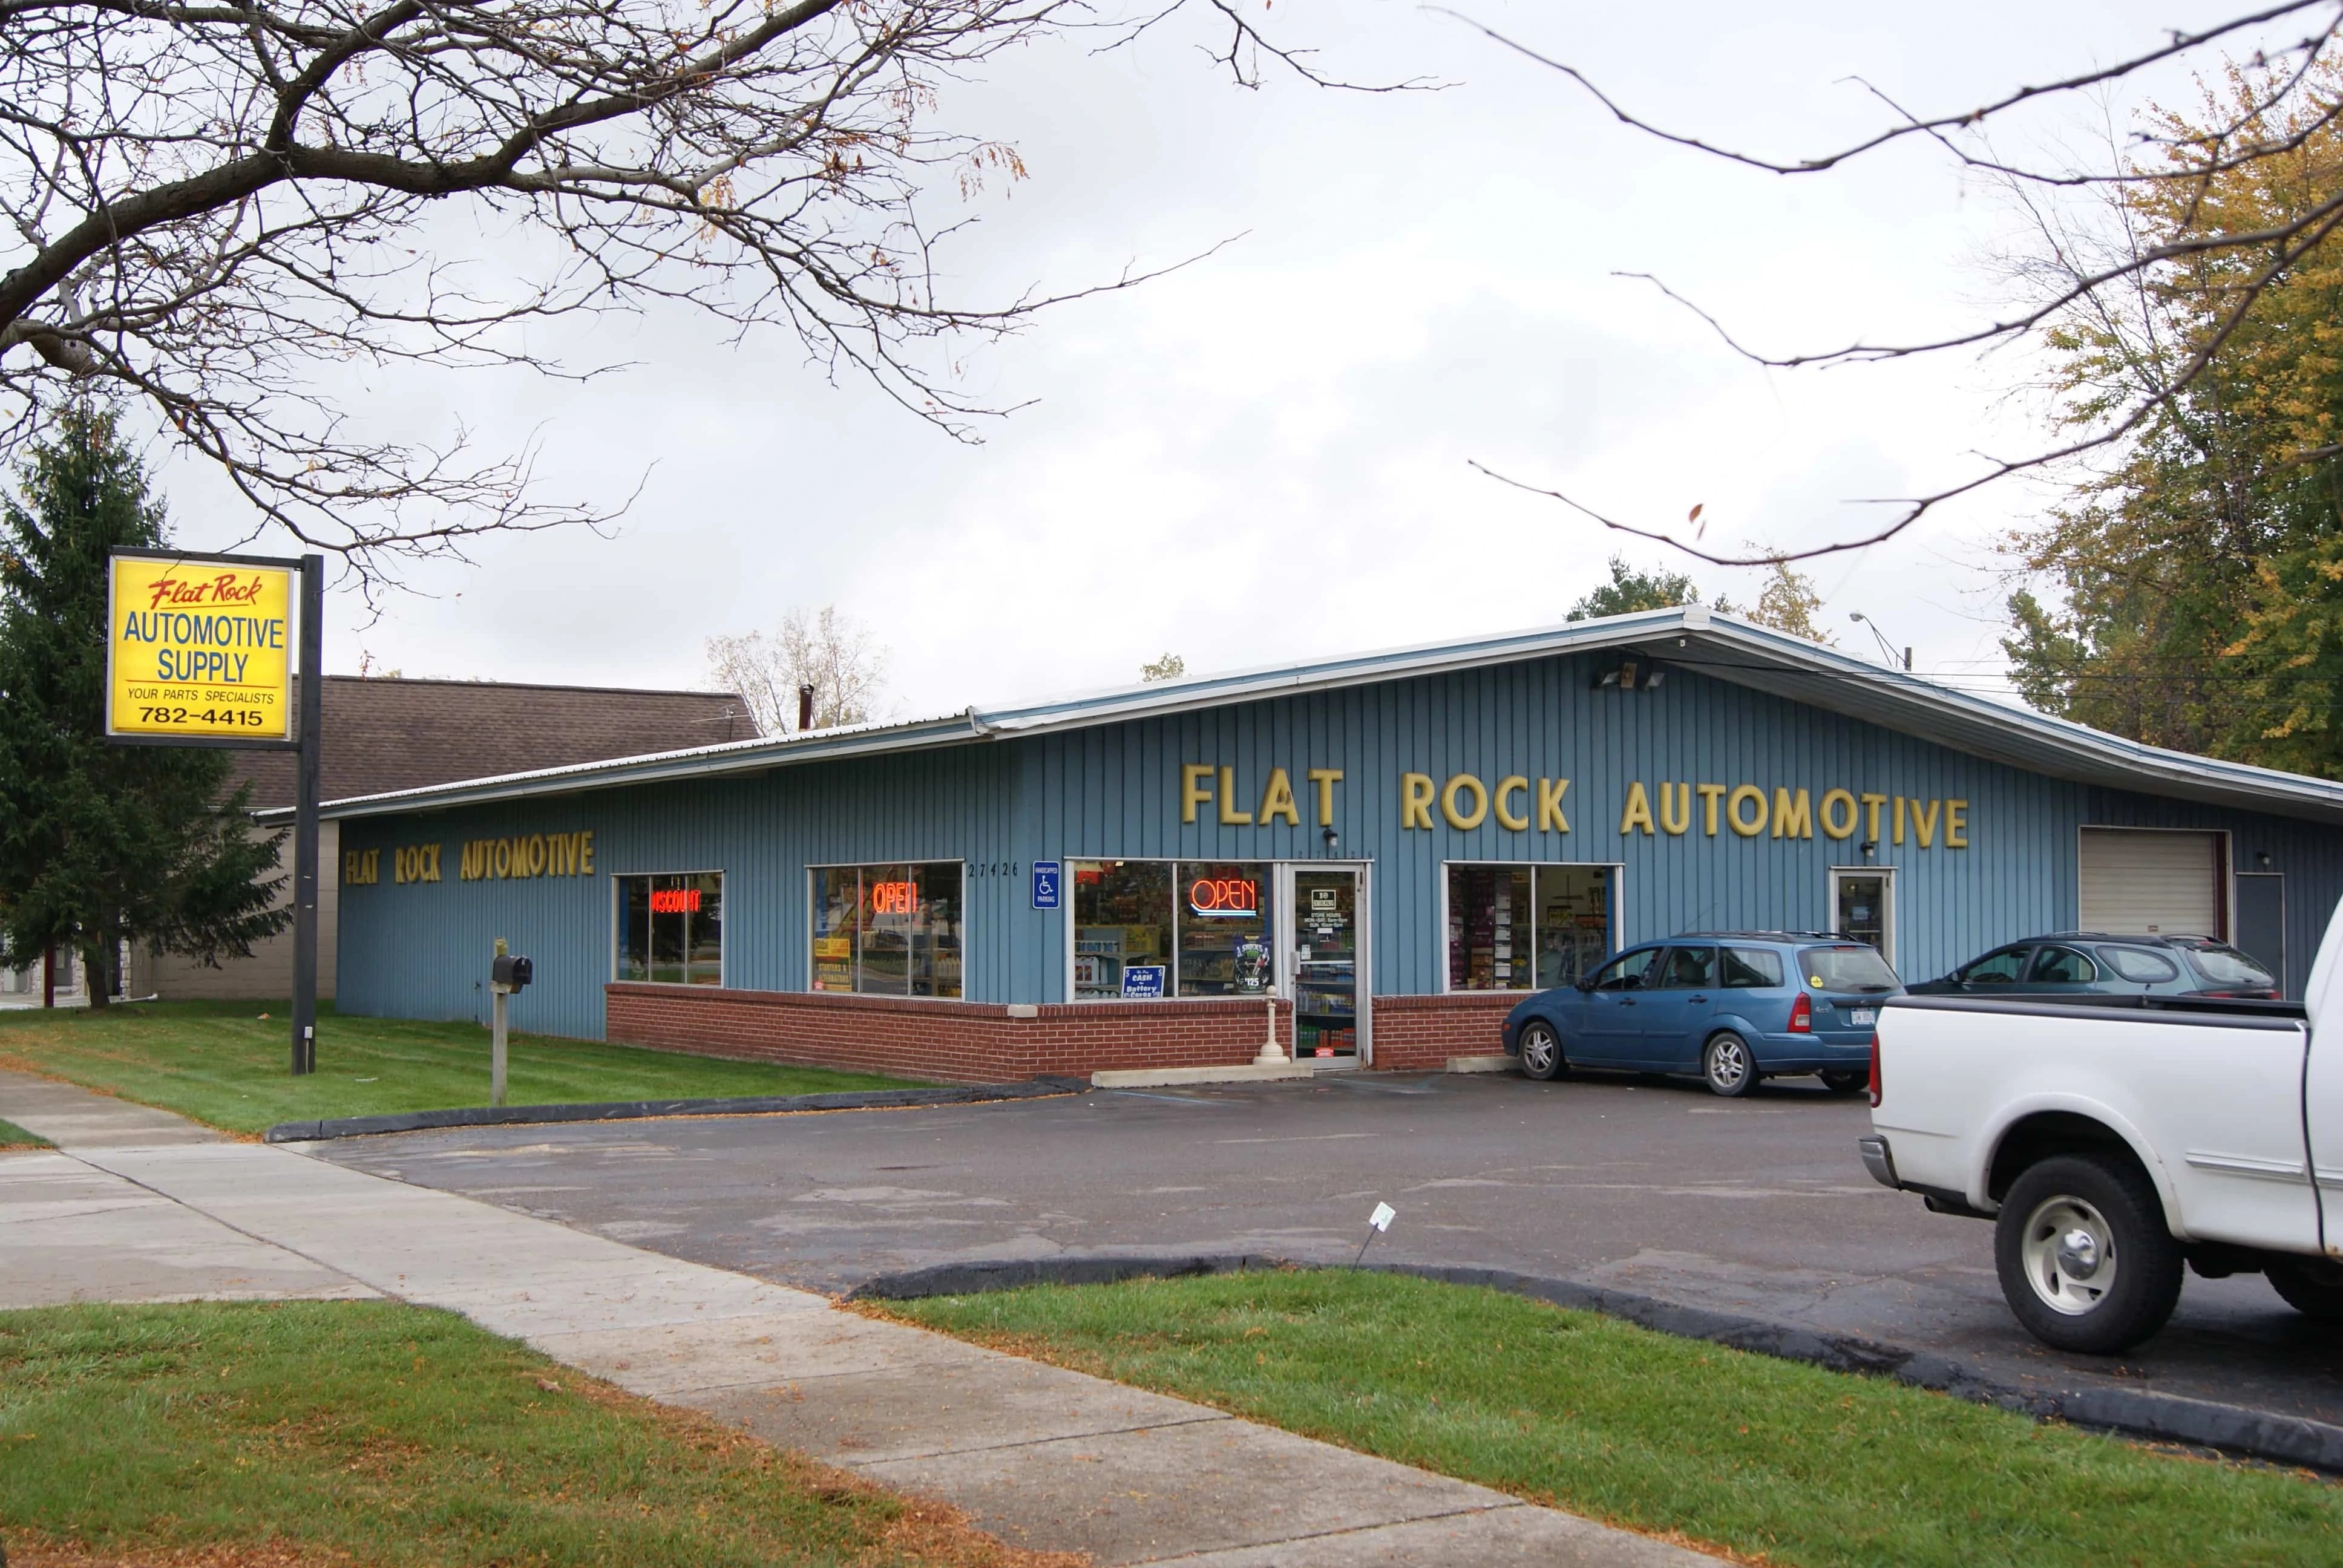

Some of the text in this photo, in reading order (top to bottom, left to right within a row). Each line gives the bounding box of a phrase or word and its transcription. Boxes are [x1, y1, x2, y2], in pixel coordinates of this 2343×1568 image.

[148, 574, 263, 610] Flat Rock
[123, 611, 284, 648] AUTOMOTIVE
[157, 648, 249, 682] SUPPLY
[128, 688, 274, 705] YOUR PARTS SPECIALISTS
[139, 707, 263, 727] 782-4415
[1182, 763, 1969, 849] FLAT ROCK AUTOMOTIVE
[345, 830, 595, 885] FLAT ROCK AUTOMOTIVE
[969, 862, 1017, 877] 27426
[873, 882, 917, 914] OPEN
[1191, 880, 1255, 910] OPEN
[1242, 944, 1263, 953] SHOCKS
